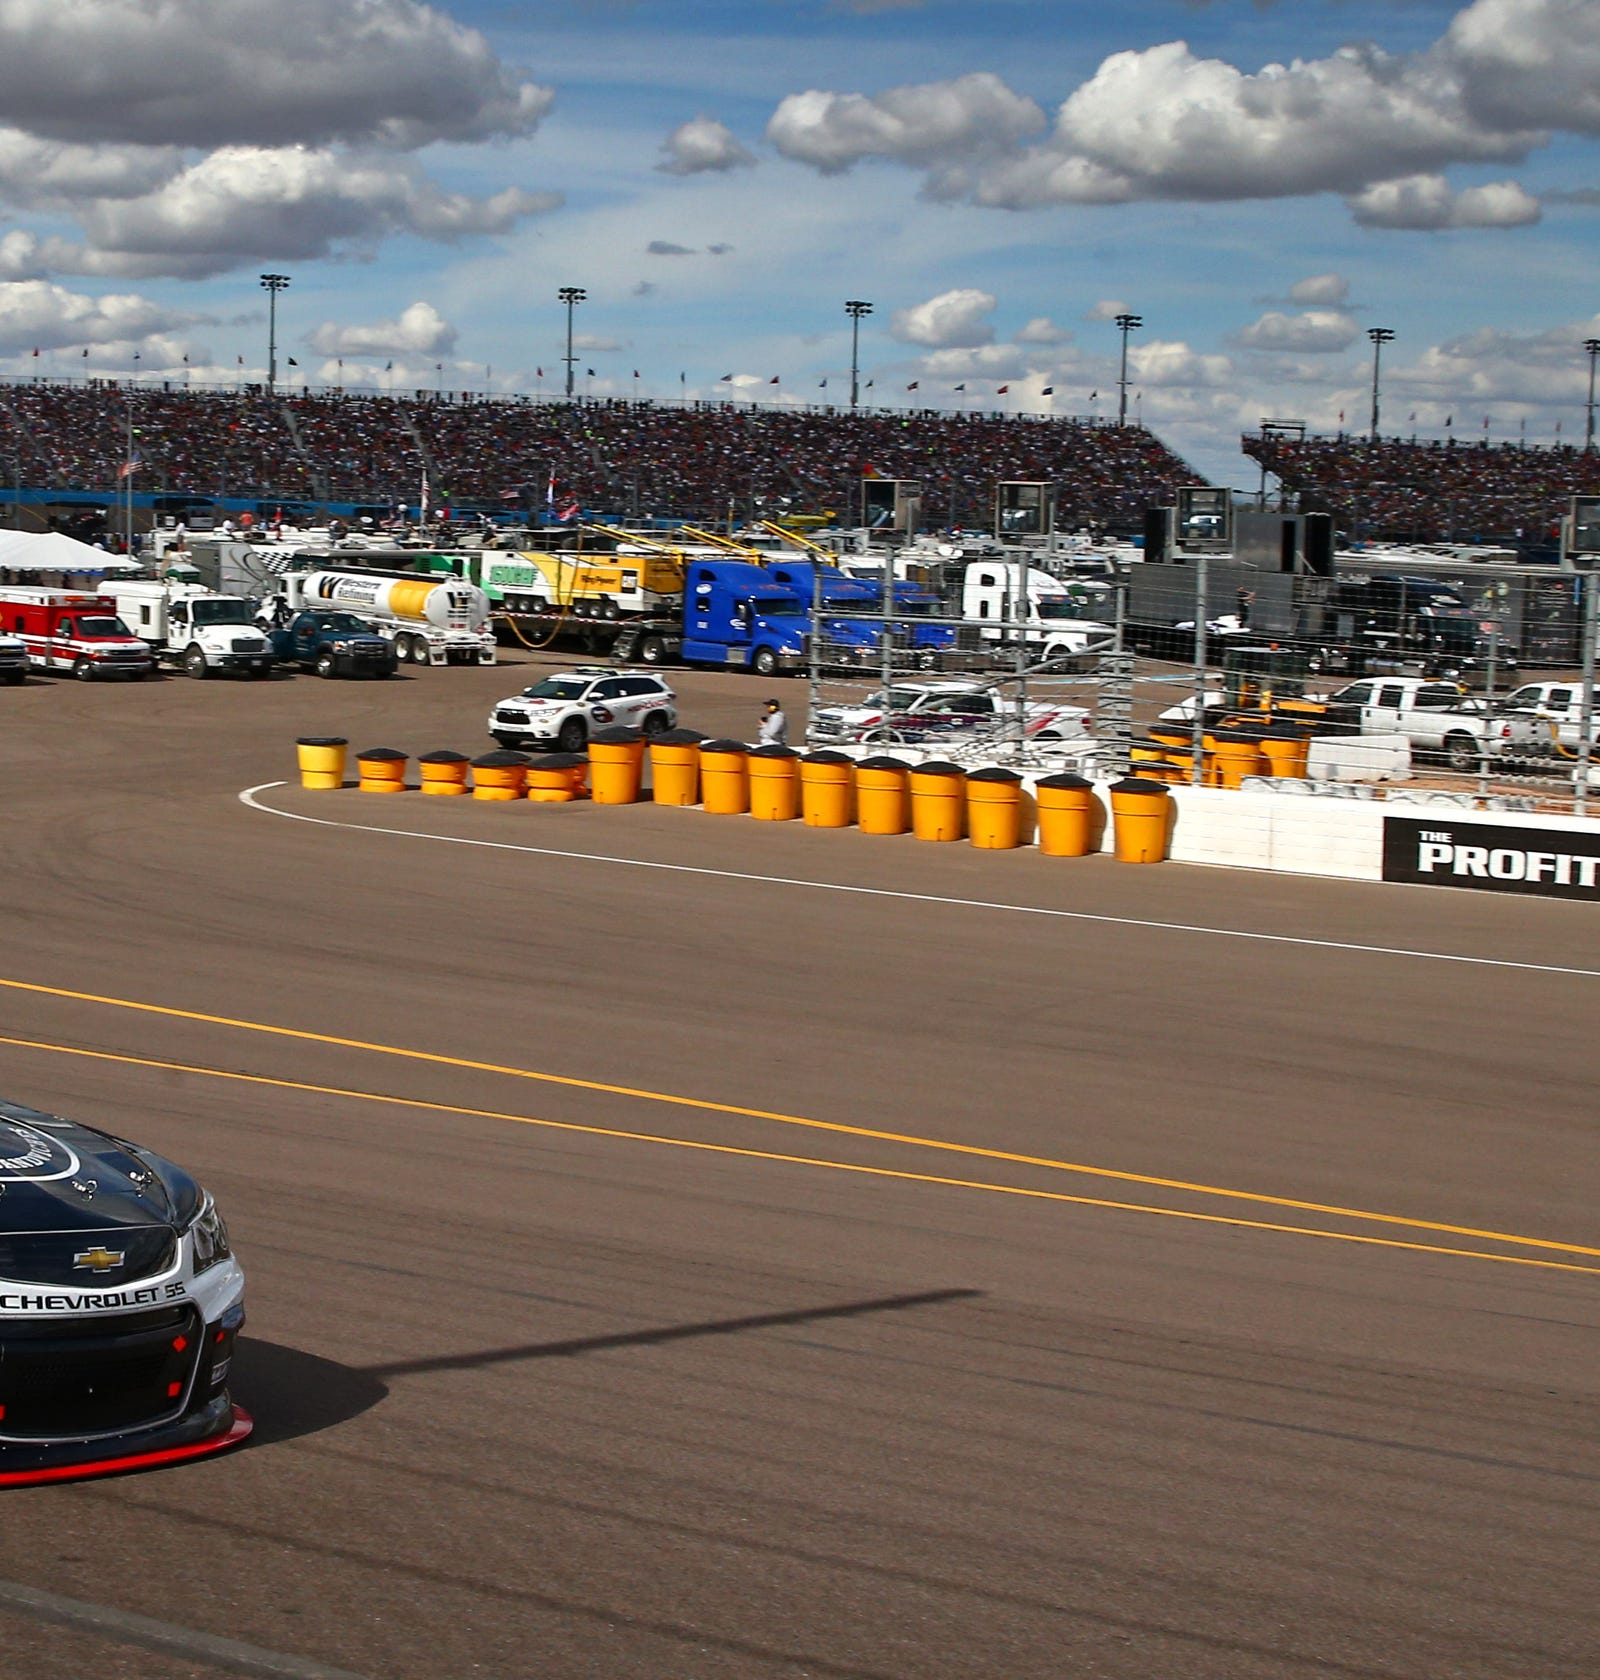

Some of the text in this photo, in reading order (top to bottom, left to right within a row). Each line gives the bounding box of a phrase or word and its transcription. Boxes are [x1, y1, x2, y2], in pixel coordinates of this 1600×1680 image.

[1418, 831, 1453, 843] THE
[1418, 842, 1600, 887] PROFIT
[0, 1286, 160, 1310] CHEVROLET
